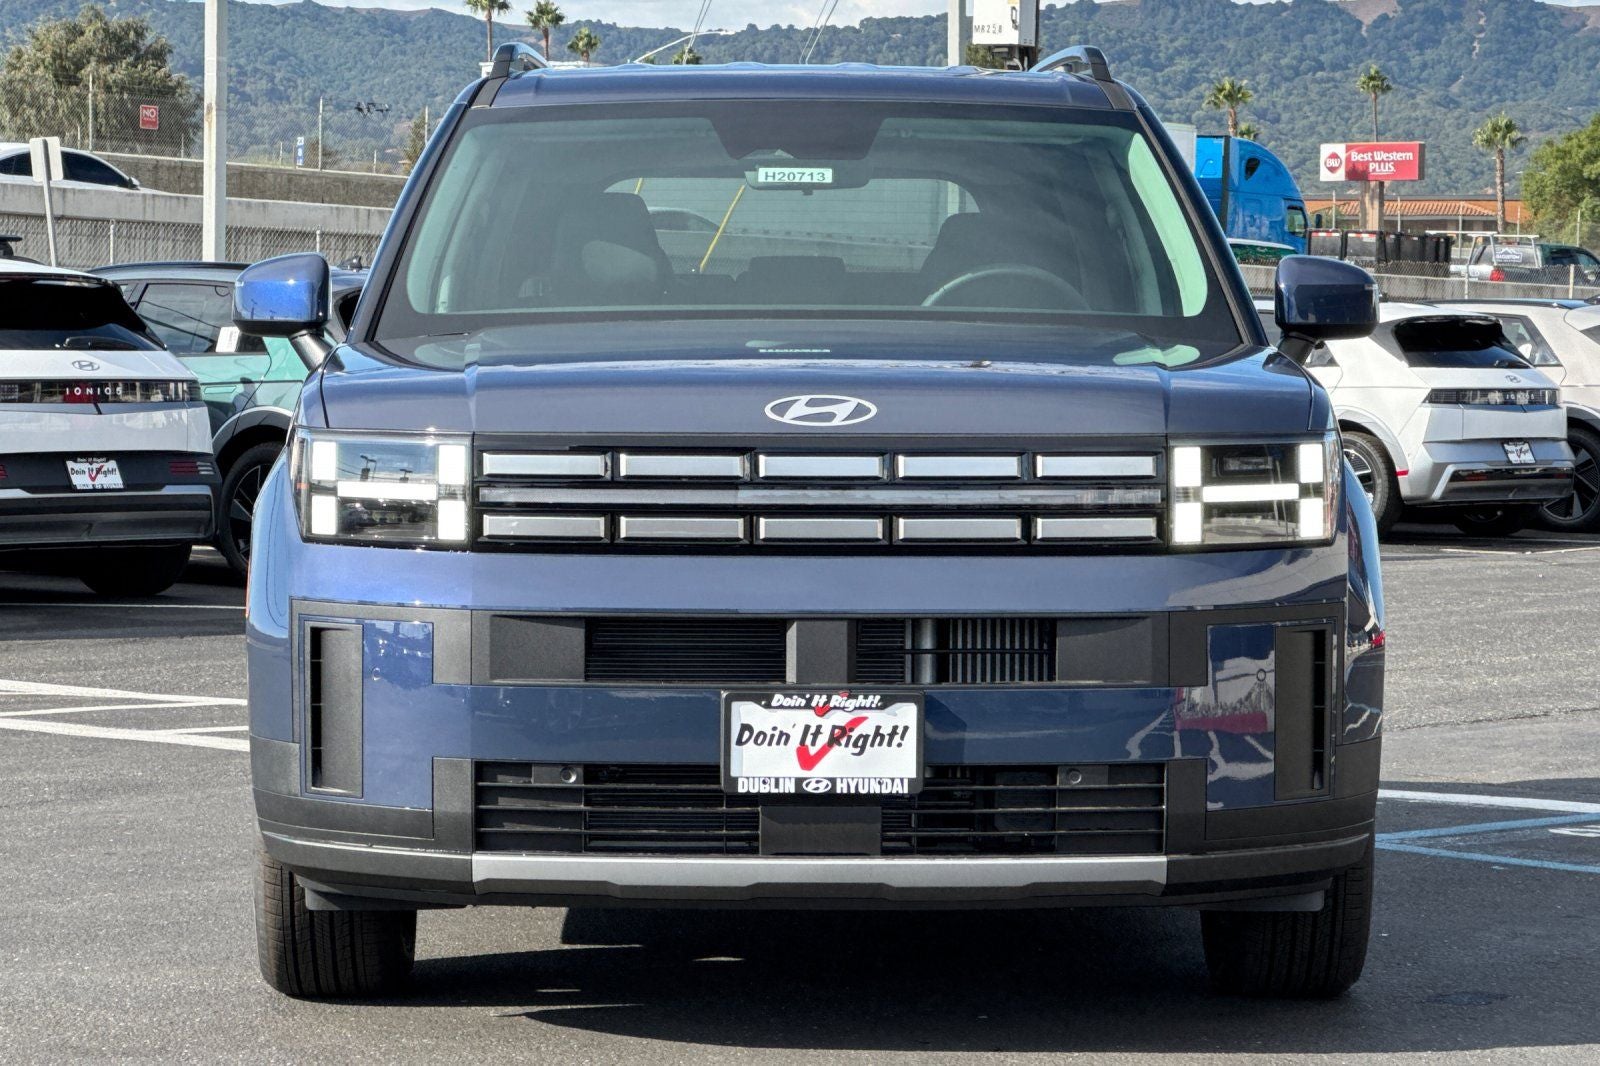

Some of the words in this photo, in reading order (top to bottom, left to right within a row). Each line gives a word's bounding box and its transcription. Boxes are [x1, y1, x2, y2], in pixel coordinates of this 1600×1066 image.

[143, 109, 156, 118] NO
[1350, 151, 1373, 162] Best
[1373, 150, 1414, 161] Western
[1326, 159, 1341, 168] BW
[764, 171, 826, 182] H20713
[770, 693, 810, 708] Doin'
[811, 694, 828, 707] It
[830, 694, 881, 712] Right!
[735, 722, 797, 747] Doin'
[800, 723, 823, 747] It
[826, 724, 910, 757] Right!
[737, 777, 796, 794] DUBLIN
[836, 777, 909, 795] HYUNDAI
